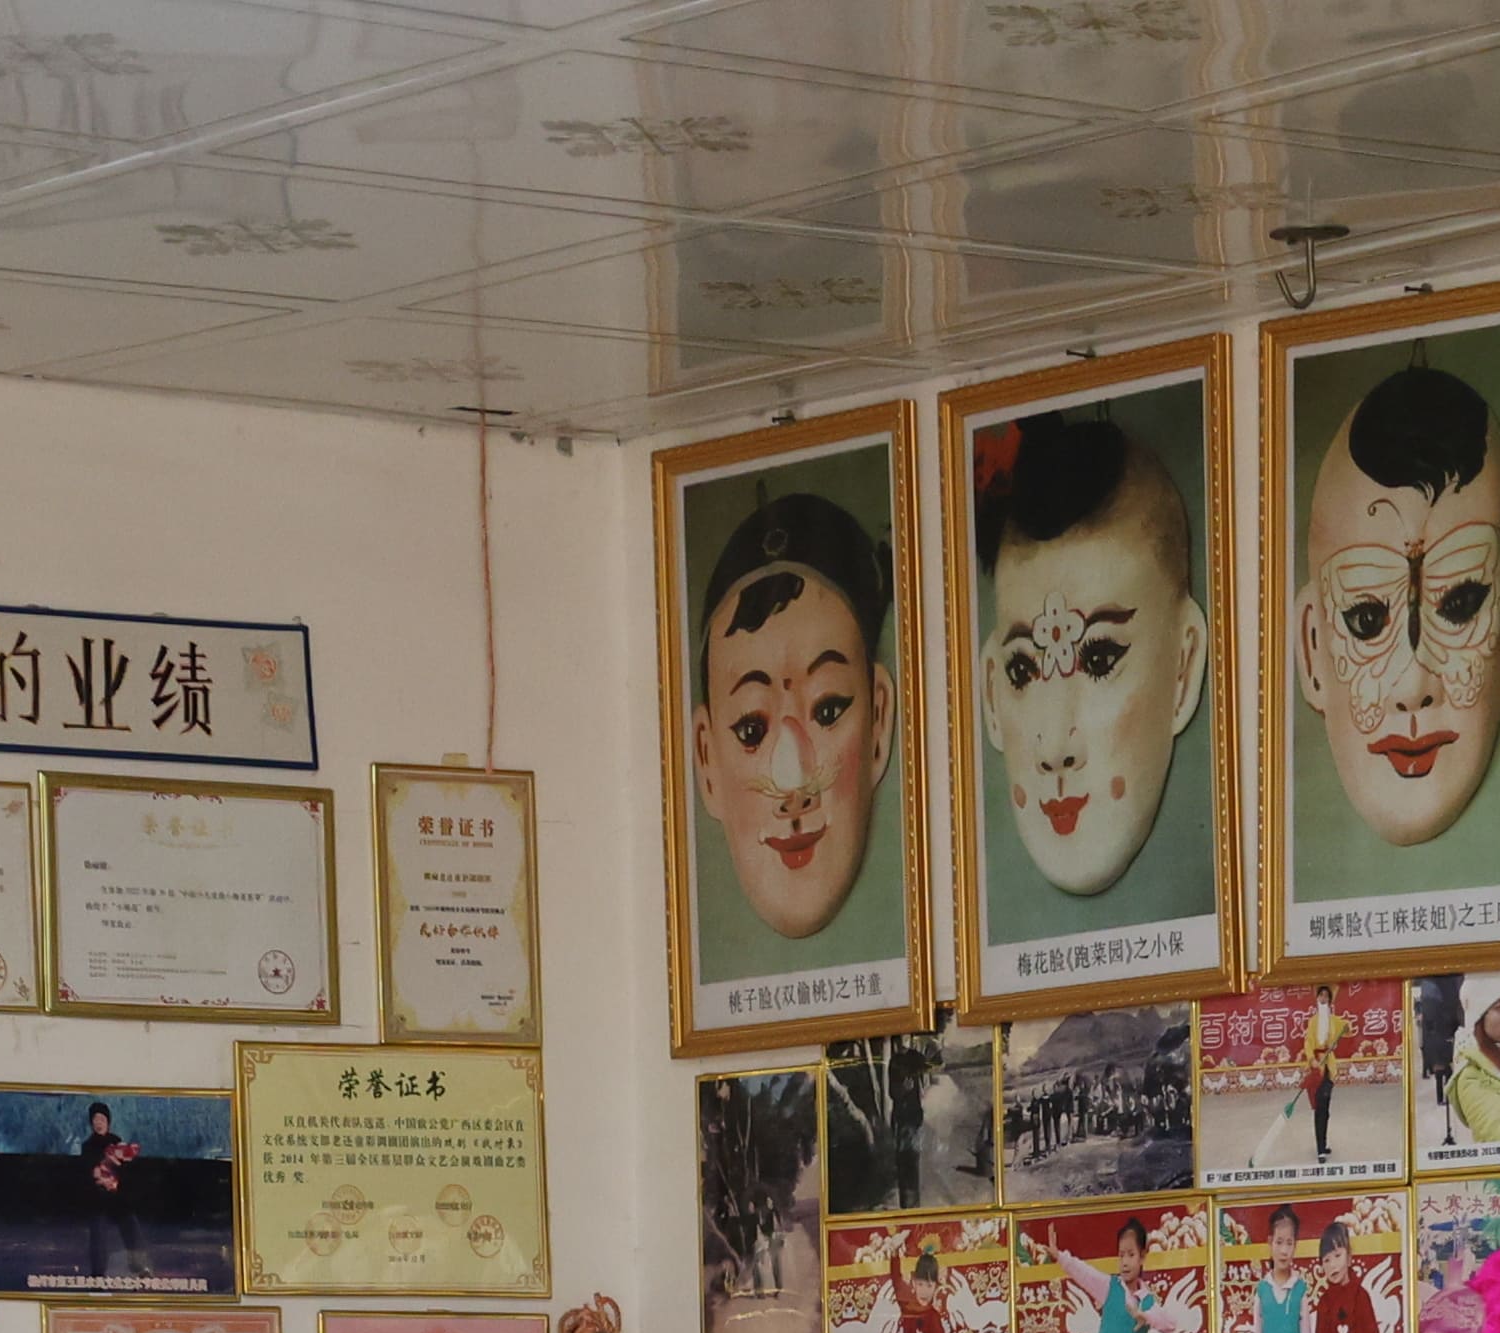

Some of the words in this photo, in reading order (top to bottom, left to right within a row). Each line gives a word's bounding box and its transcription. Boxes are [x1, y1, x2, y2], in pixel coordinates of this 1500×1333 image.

[418, 815, 495, 838] 荣誉证书
[1017, 930, 1185, 978] 梅花脸《跑菜园》之小保
[727, 973, 884, 1015] 桃子脸《双偷桃》之书童
[338, 1067, 447, 1101] 荣誉证书
[280, 1155, 304, 1164] 2014
